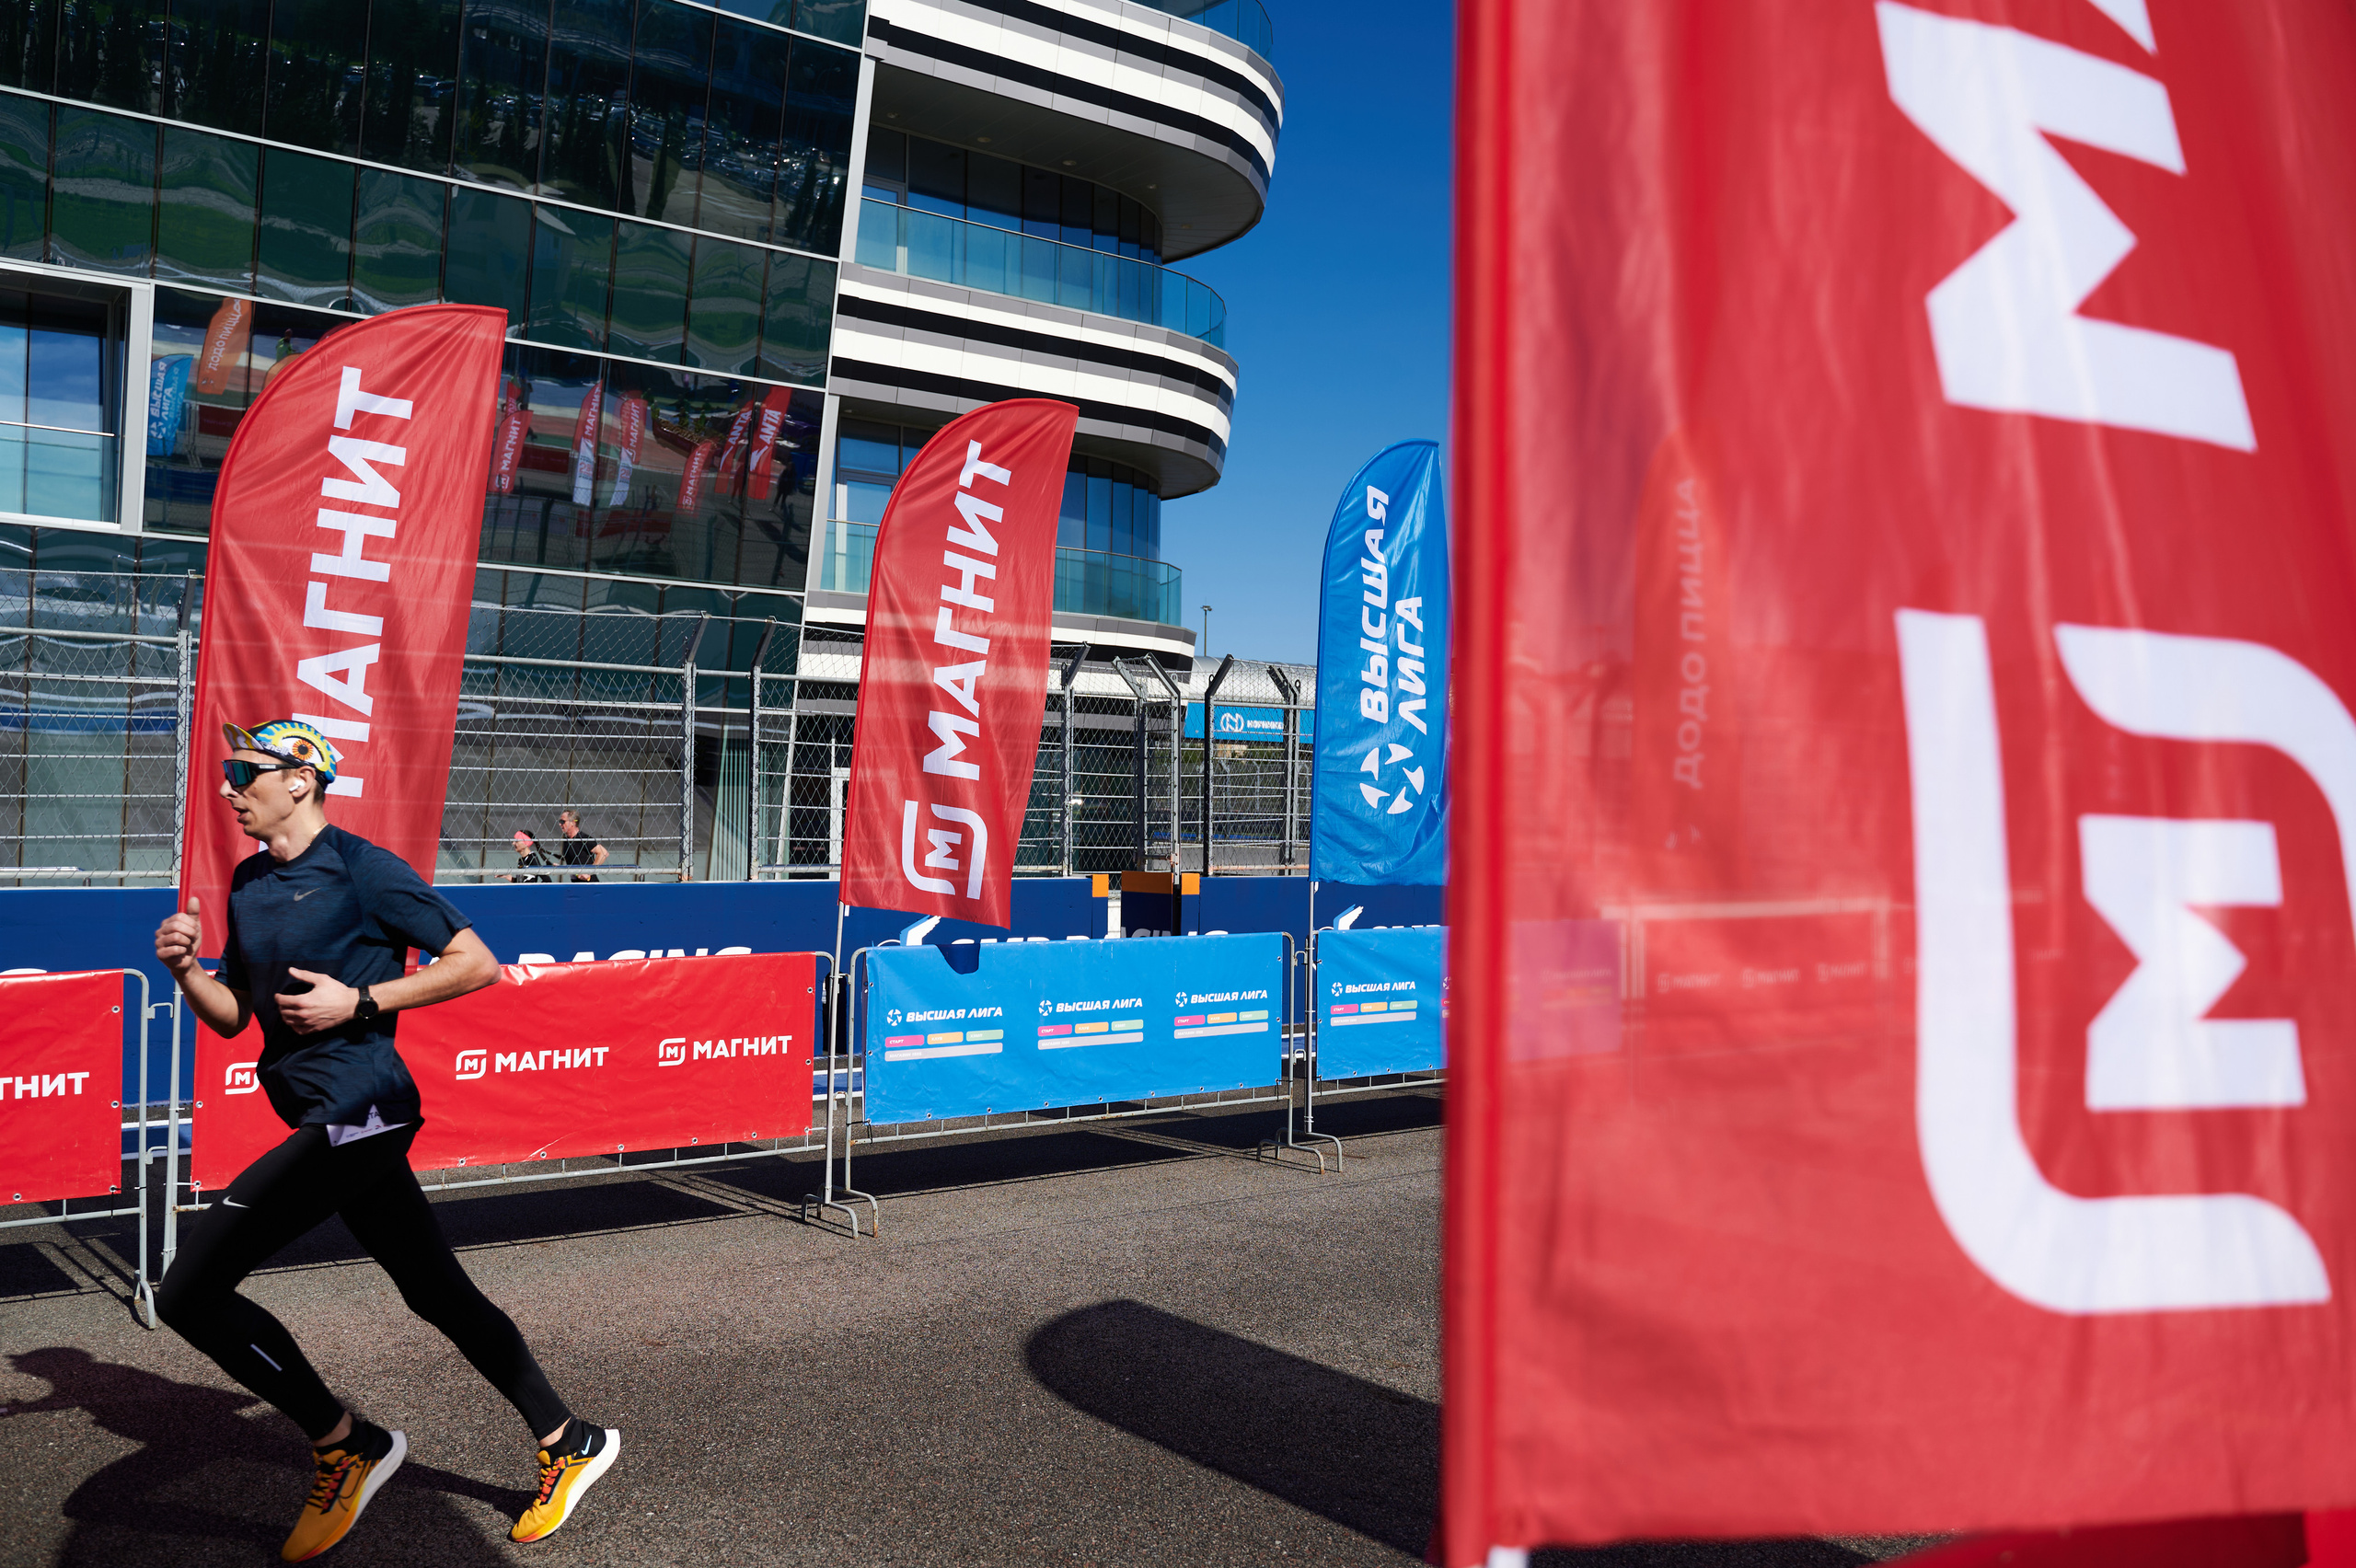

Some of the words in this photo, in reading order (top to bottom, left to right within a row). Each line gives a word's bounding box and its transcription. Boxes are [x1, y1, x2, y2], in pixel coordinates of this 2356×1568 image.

[1876, 0, 2256, 451] М
[629, 402, 640, 448] МАГНИТ
[728, 409, 752, 445] ANTA
[759, 409, 782, 445] ANTA
[501, 417, 522, 471] МАГНИТ
[687, 451, 701, 495] МАГНИТ
[922, 439, 1013, 782] МАГНИТ
[1359, 485, 1390, 725] ВЫСШАЯ
[1394, 596, 1427, 736] ЛИГА
[1056, 999, 1111, 1013] ВЫСШАЯ
[1111, 997, 1143, 1009] ЛИГА
[1190, 991, 1239, 1004] ВЫСШАЯ
[1240, 989, 1268, 1000] ЛИГА
[1345, 983, 1391, 994] ВЫСШАЯ
[1392, 981, 1416, 991] ЛИГА
[906, 1009, 966, 1023] ВЫСШАЯ
[967, 1006, 1003, 1019] ЛИГА
[494, 1047, 609, 1074] МАГНИТ
[692, 1035, 792, 1060] МАГНИТ
